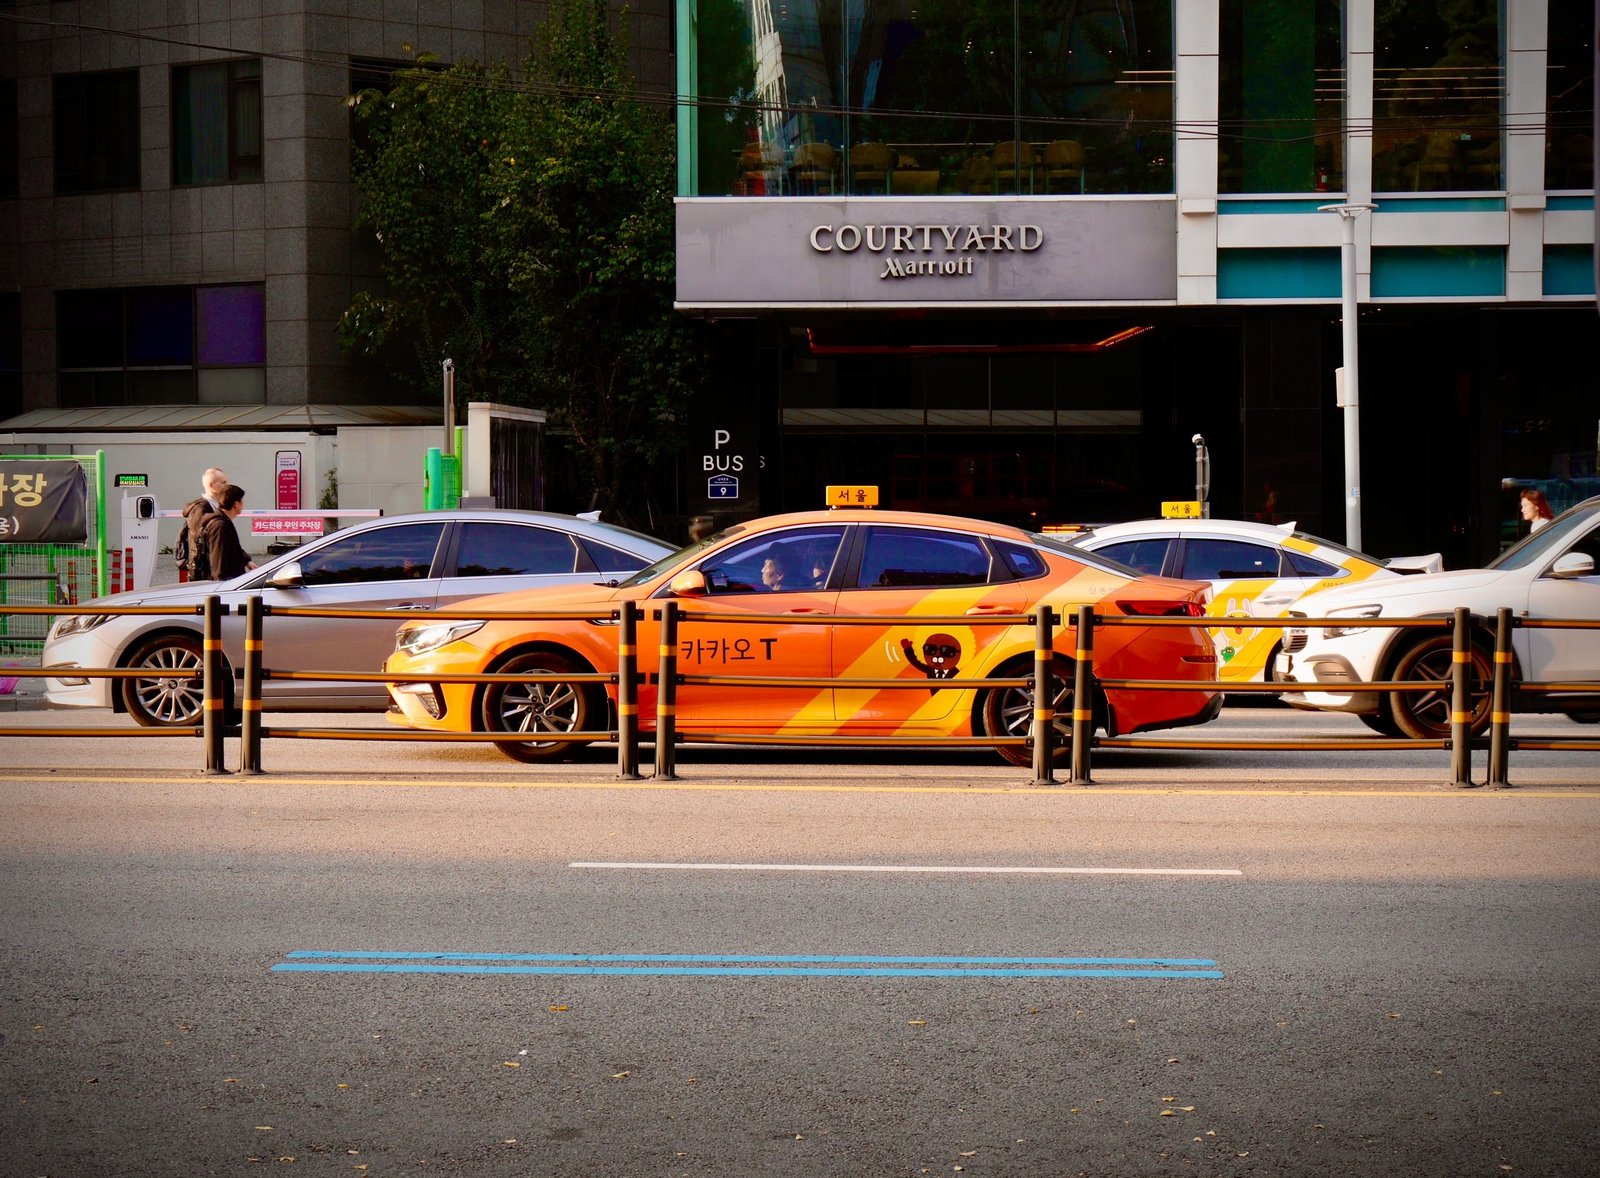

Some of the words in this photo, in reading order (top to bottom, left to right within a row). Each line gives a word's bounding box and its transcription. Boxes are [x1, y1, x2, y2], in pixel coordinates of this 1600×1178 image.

[809, 224, 1044, 253] COURTYARD
[880, 257, 974, 279] Marriott
[715, 429, 731, 450] P
[703, 454, 744, 472] BUS
[720, 487, 727, 496] 9
[838, 489, 867, 503] 서울
[284, 521, 298, 530] 무인
[299, 521, 321, 530] 주차장
[681, 638, 755, 665] 카카오
[759, 638, 778, 660] T
